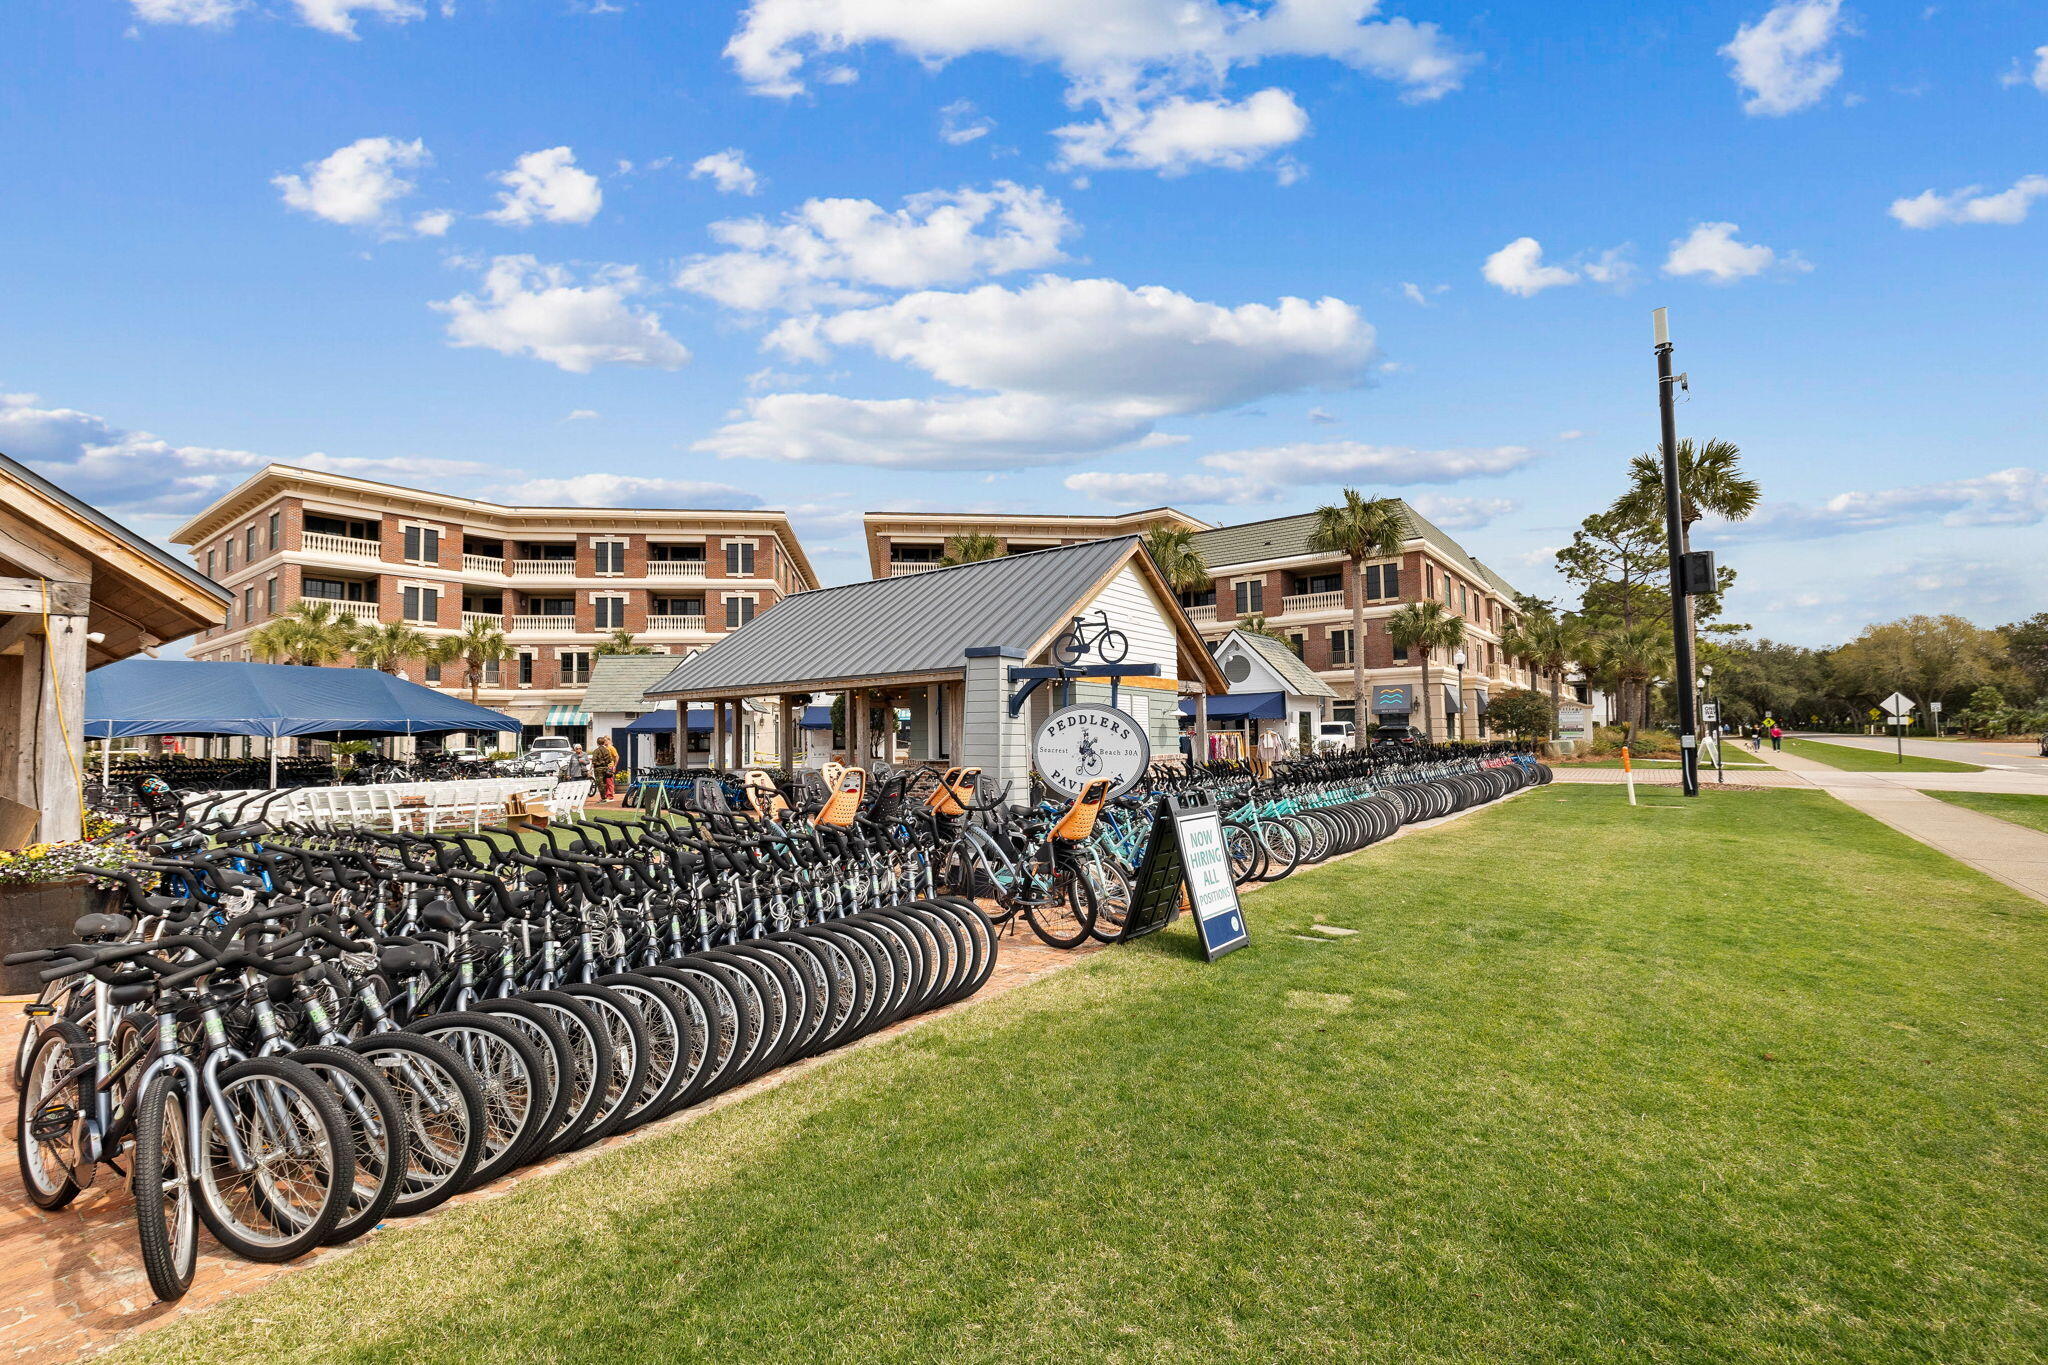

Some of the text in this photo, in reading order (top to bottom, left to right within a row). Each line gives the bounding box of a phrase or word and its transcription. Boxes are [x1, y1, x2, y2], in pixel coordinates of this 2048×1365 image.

[1047, 714, 1130, 740] PEDDLERS
[1039, 746, 1068, 754] Seacrest
[1099, 748, 1121, 756] Beach
[1051, 769, 1125, 793] PAVIN
[1190, 829, 1213, 849] NOW
[1190, 847, 1222, 869] HIRING
[1203, 870, 1220, 888] ALL
[1200, 887, 1231, 905] POSITIONS
